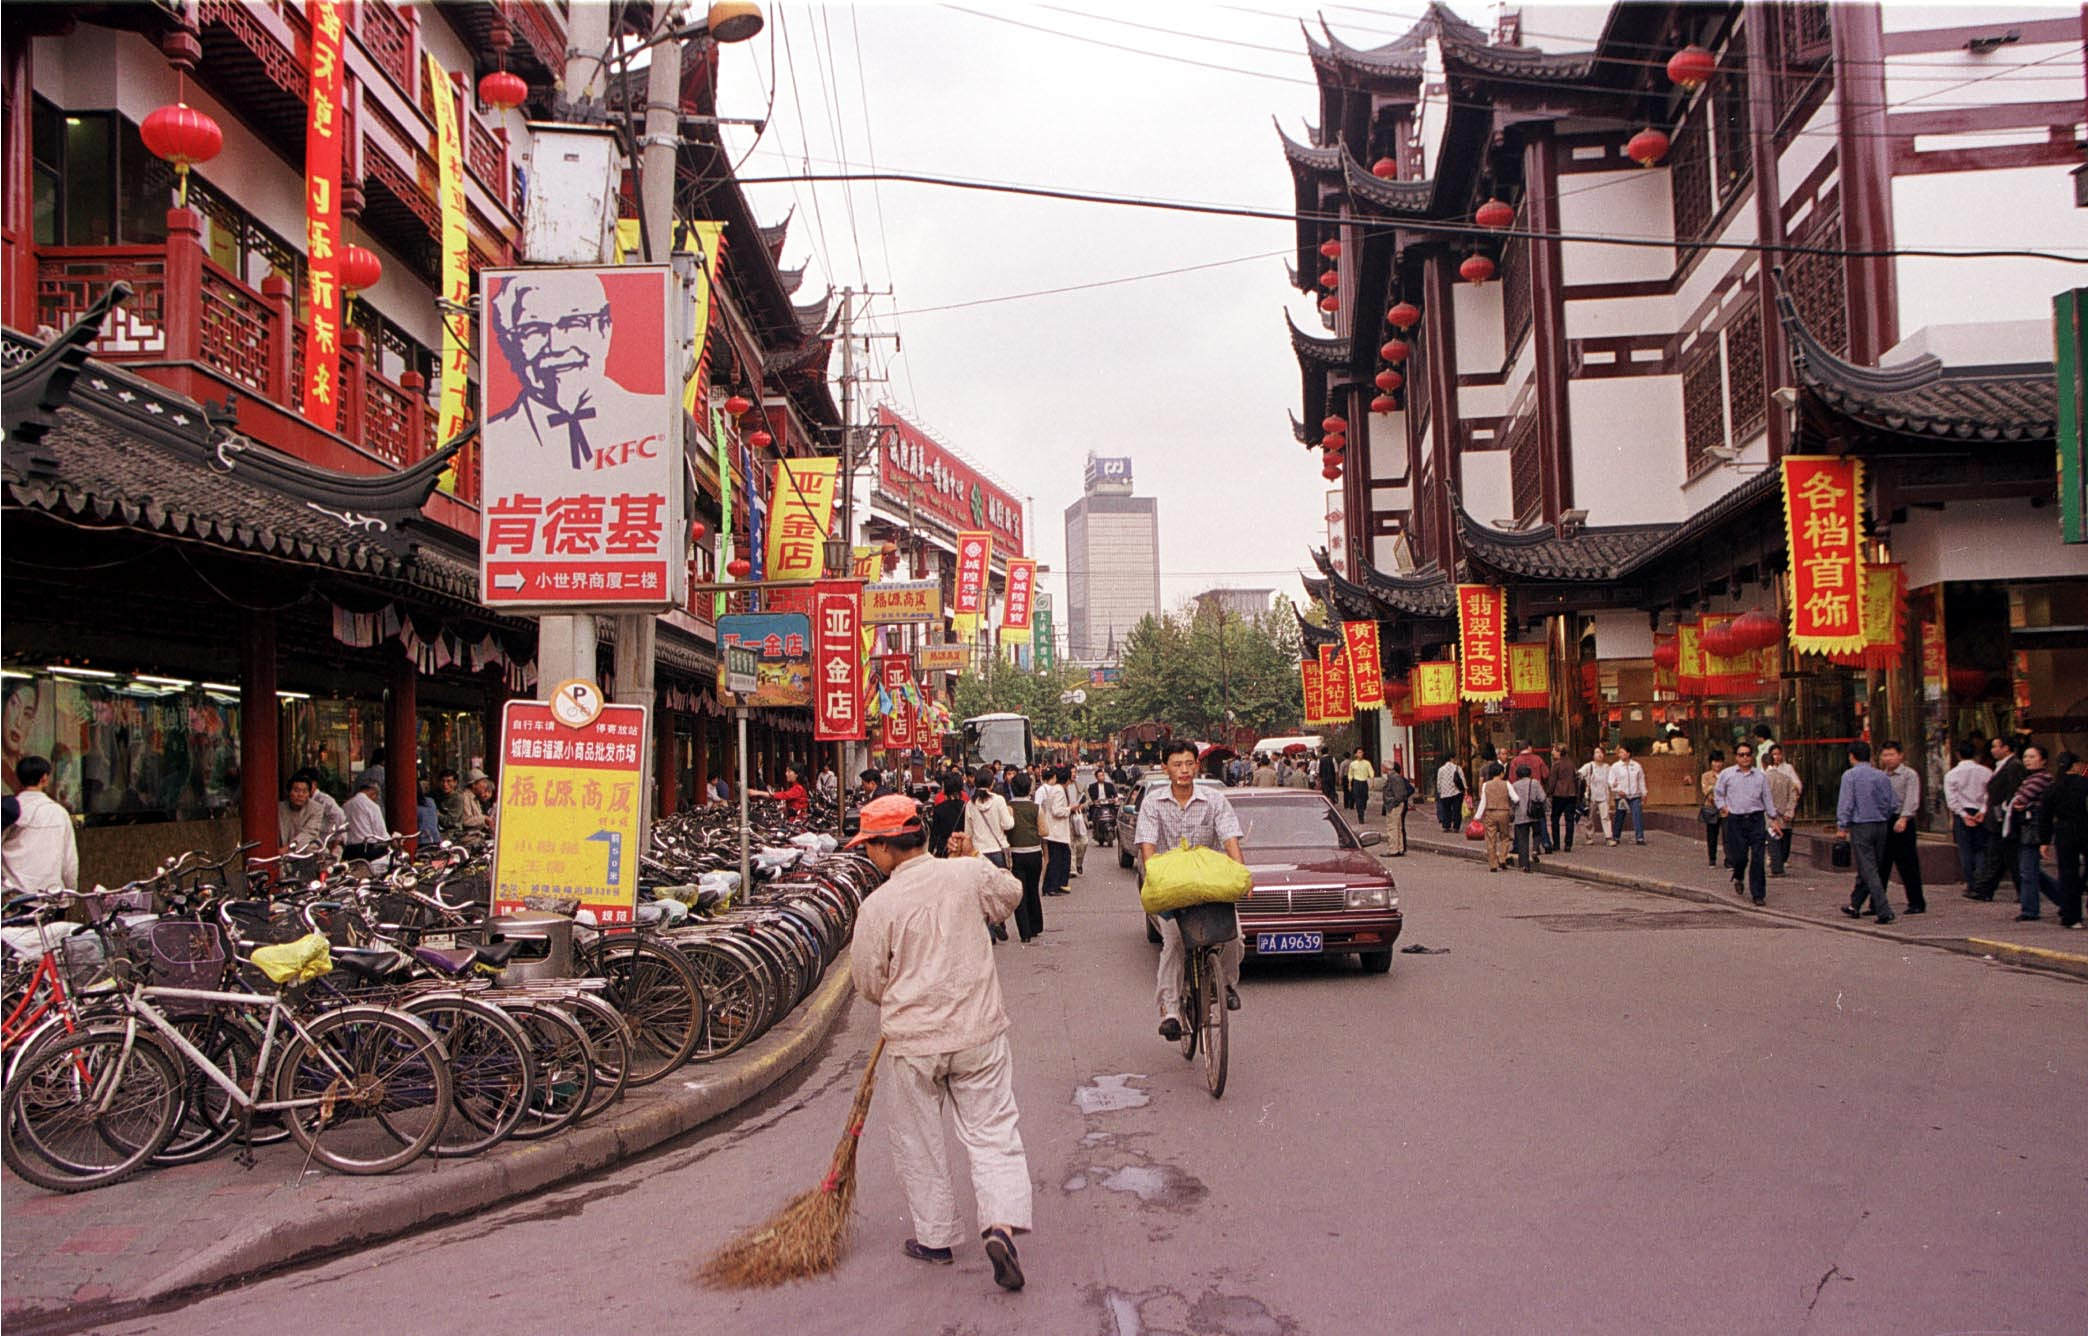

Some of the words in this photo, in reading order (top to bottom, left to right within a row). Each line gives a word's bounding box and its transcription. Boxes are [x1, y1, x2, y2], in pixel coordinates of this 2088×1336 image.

[593, 435, 657, 471] KFC
[486, 493, 666, 554] 肯德基
[777, 471, 824, 570] 亚一金店
[1798, 471, 1851, 628] 各档首饰
[535, 571, 658, 590] 小世界商厦二楼
[824, 608, 852, 719] 亚一金店
[1349, 623, 1379, 698] 黄金珠宝
[1467, 593, 1497, 686] 翡翠玉器
[512, 719, 556, 732] 自行车请
[511, 738, 637, 763] 城隍庙福源小商品批发市场
[508, 775, 635, 813] 福源商厦
[1280, 935, 1320, 950] A9639
